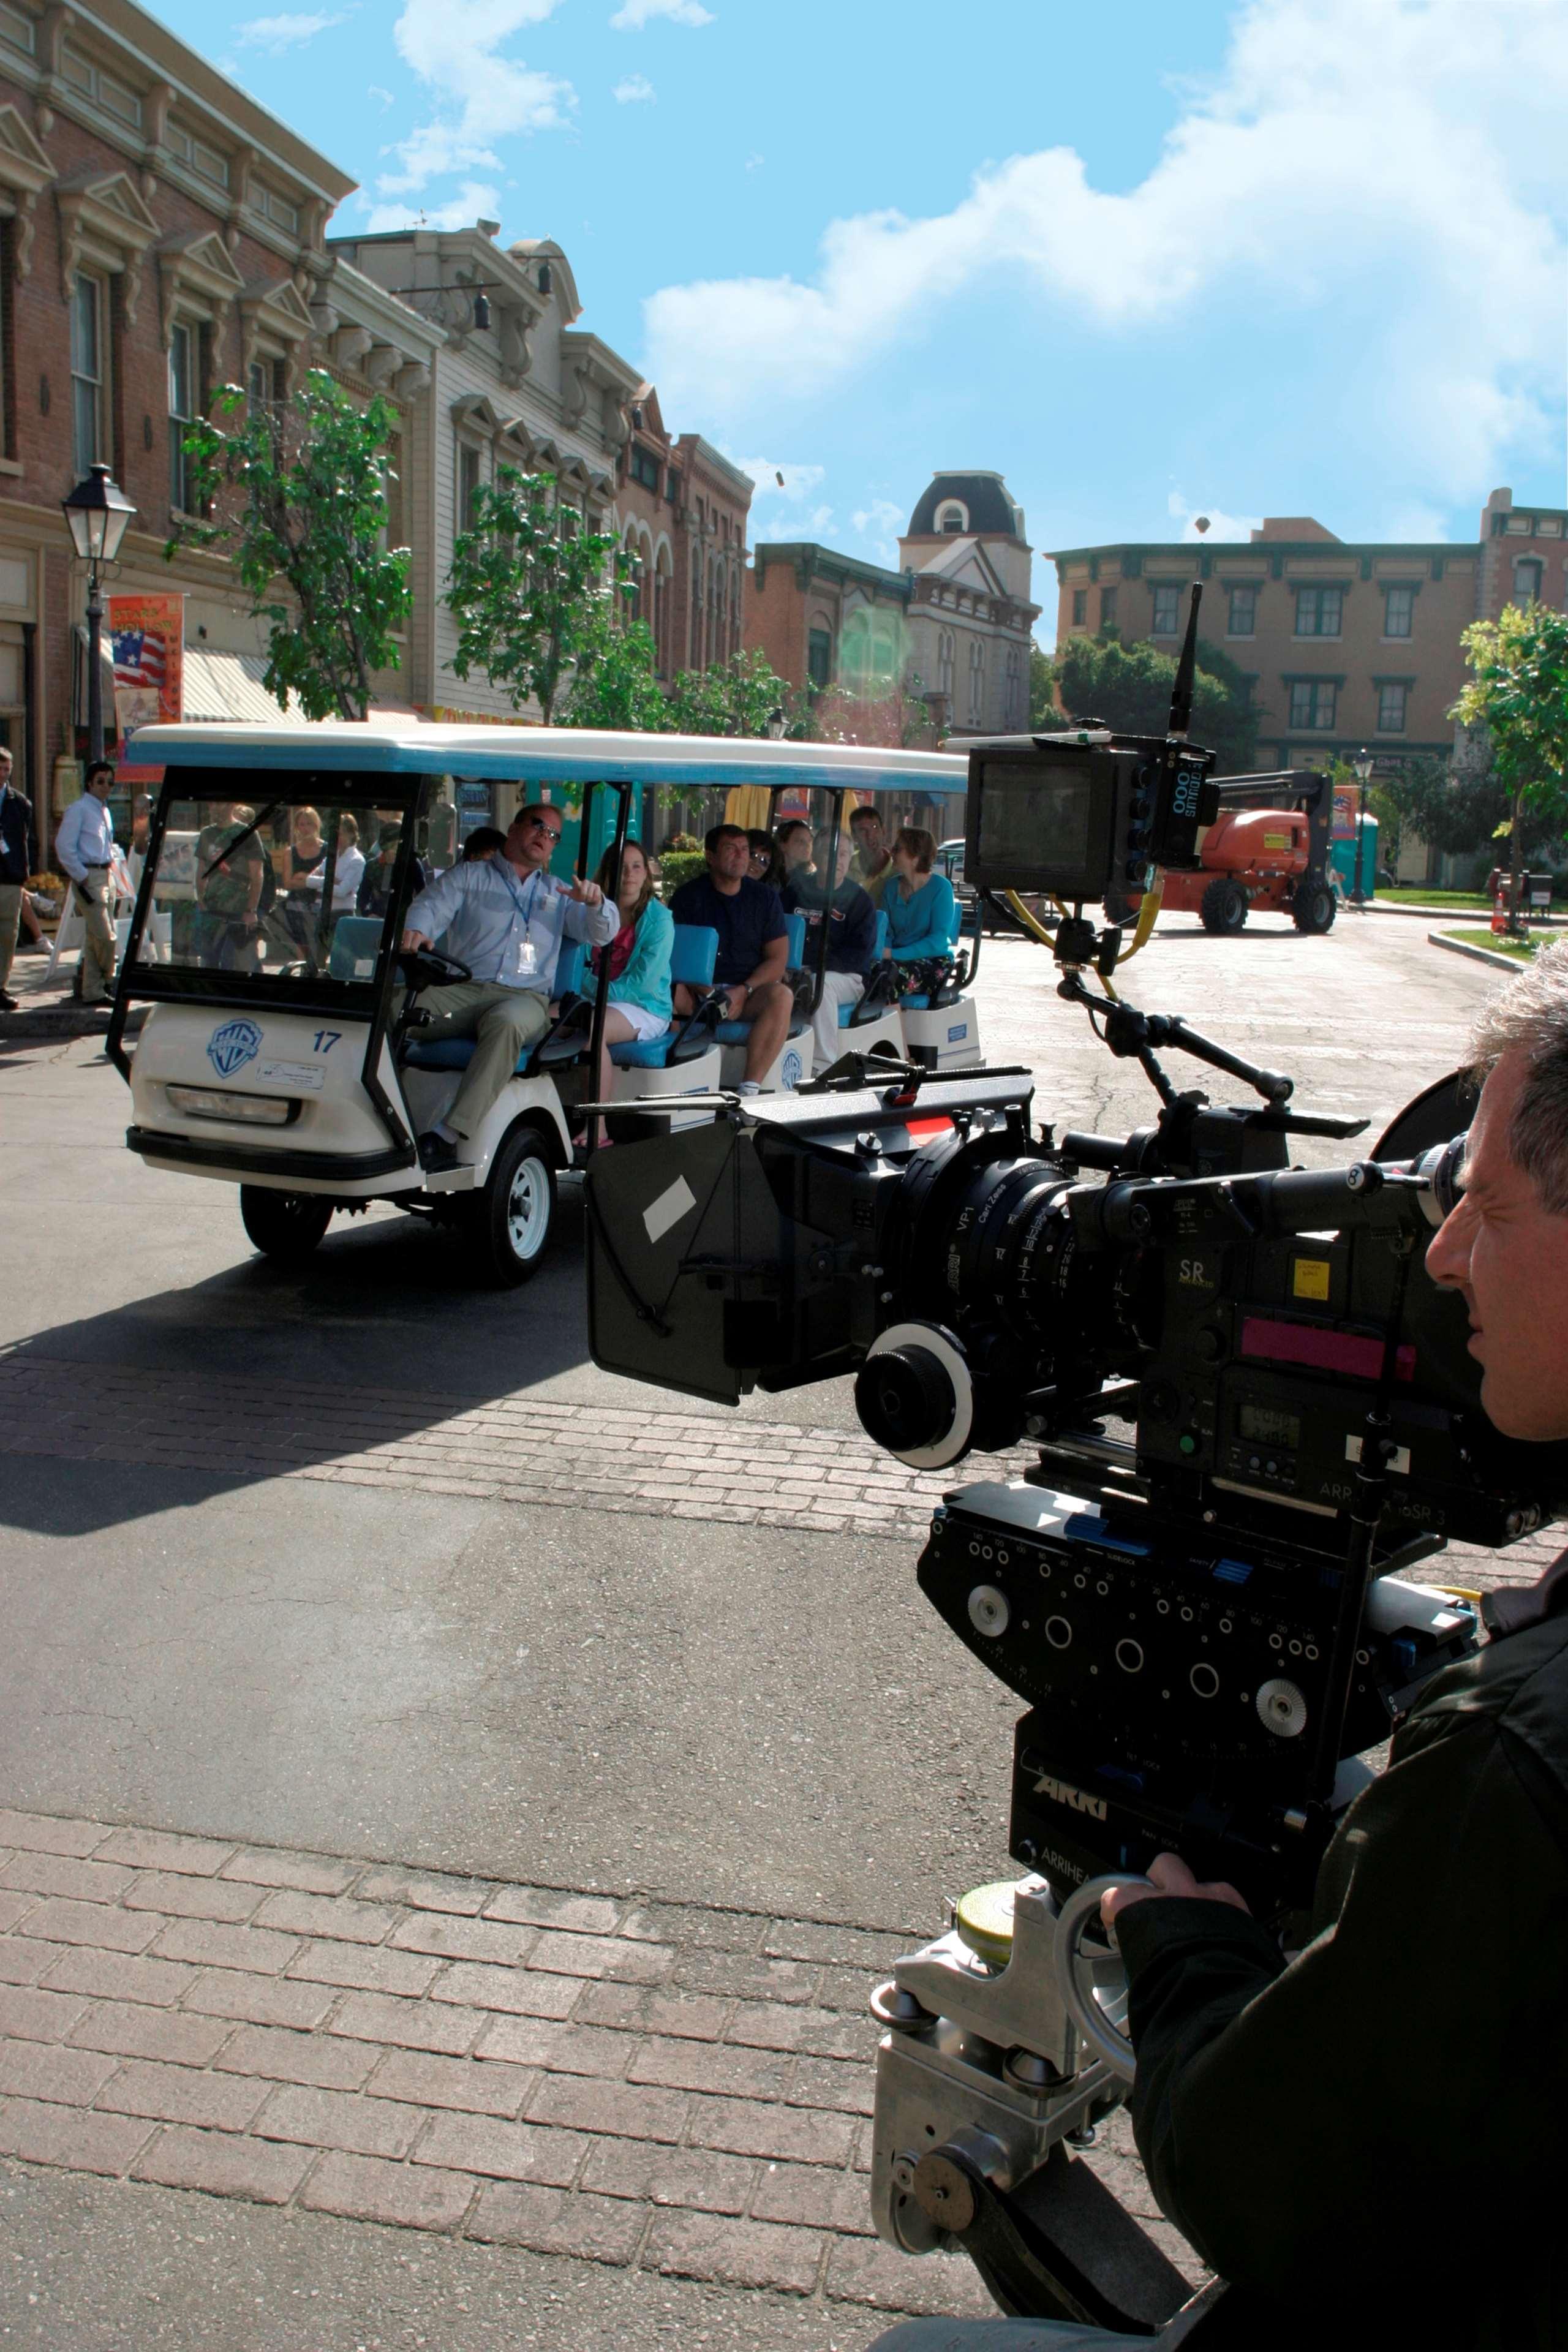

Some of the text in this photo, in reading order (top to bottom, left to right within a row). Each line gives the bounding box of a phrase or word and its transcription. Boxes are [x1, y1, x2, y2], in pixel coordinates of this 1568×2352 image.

[115, 609, 158, 620] STARS
[115, 620, 173, 633] HOLLOW
[313, 1030, 342, 1053] 17
[1348, 1169, 1359, 1185] 8
[956, 1206, 974, 1231] VP1
[978, 1202, 994, 1224] Carl
[1025, 1238, 1035, 1248] 10
[947, 1254, 960, 1297] ARRI
[1059, 1265, 1069, 1276] 18
[1179, 1259, 1204, 1284] SR
[1059, 1278, 1068, 1289] 16
[1436, 1509, 1446, 1526] 3
[1032, 1776, 1108, 1823] ARRI
